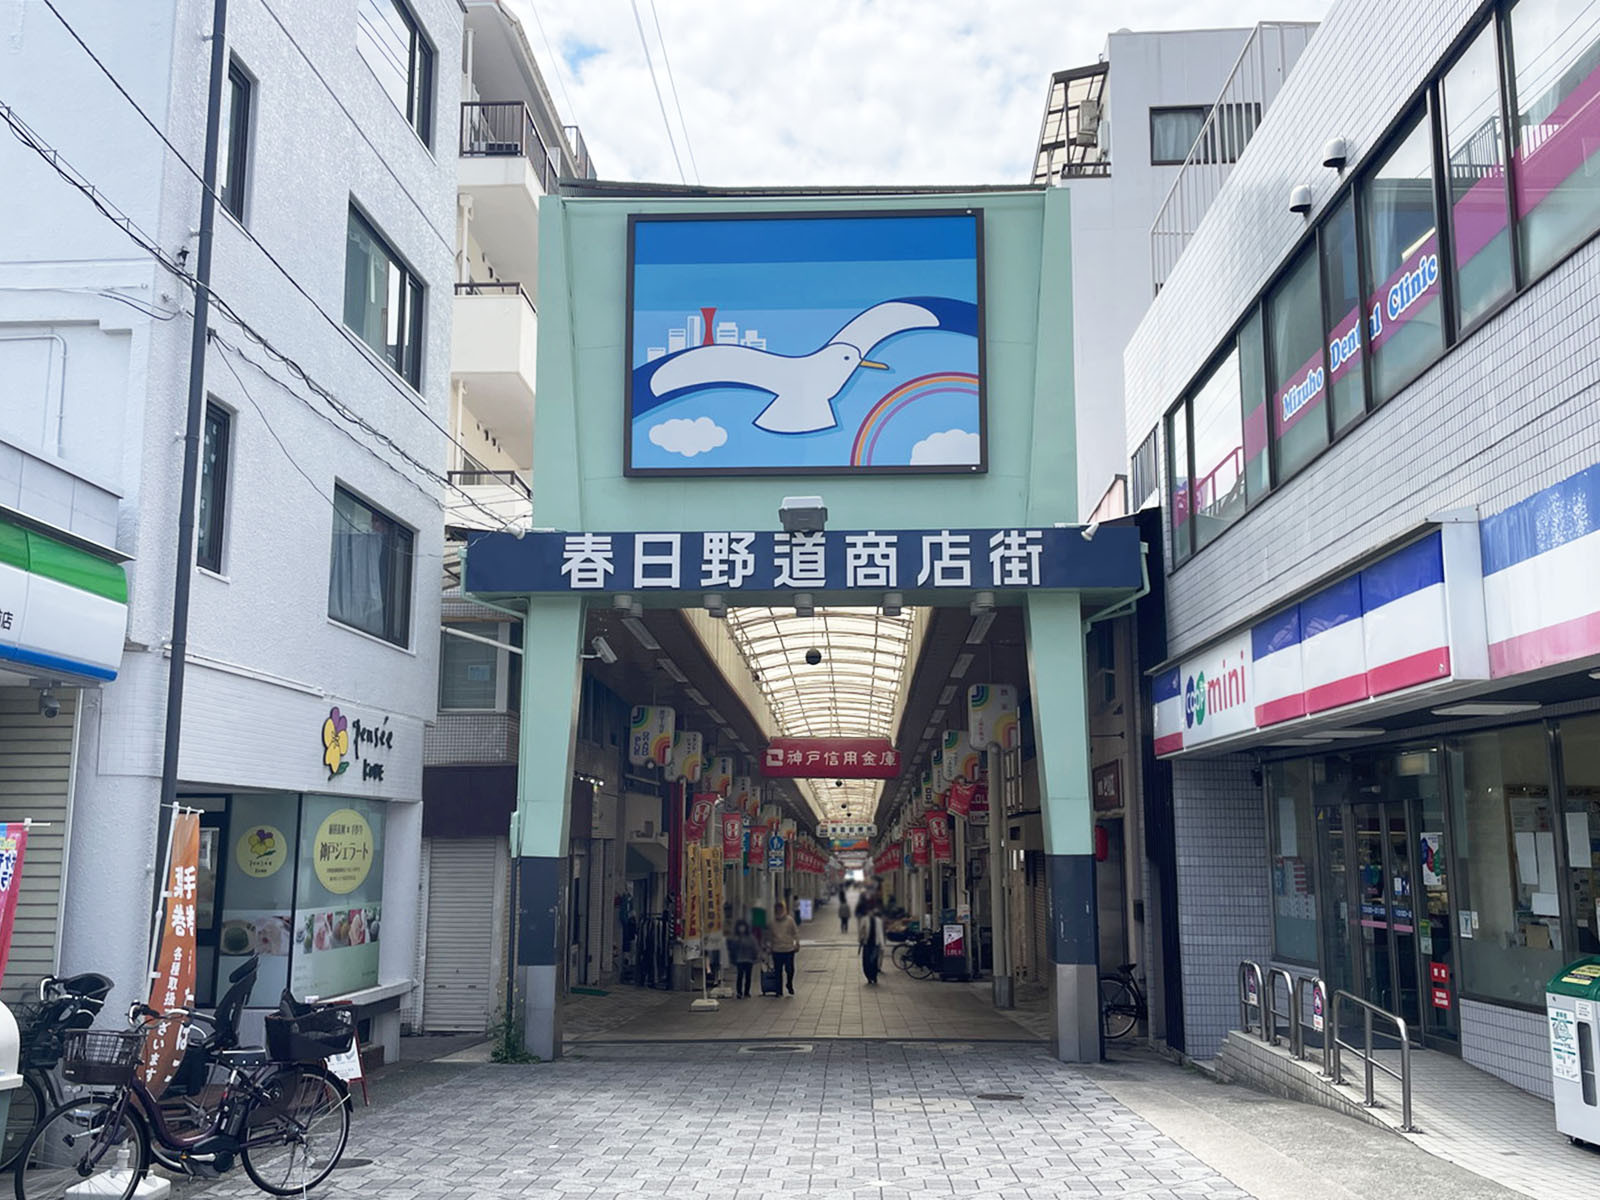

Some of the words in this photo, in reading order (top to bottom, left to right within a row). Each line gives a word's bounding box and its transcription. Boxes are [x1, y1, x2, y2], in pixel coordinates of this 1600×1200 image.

[1283, 367, 1325, 421] Mizuho
[1387, 254, 1438, 321] Clinic
[560, 529, 1043, 589] 春日野道商店街
[1207, 649, 1246, 716] mini
[786, 749, 897, 767] 神戸信用金庫
